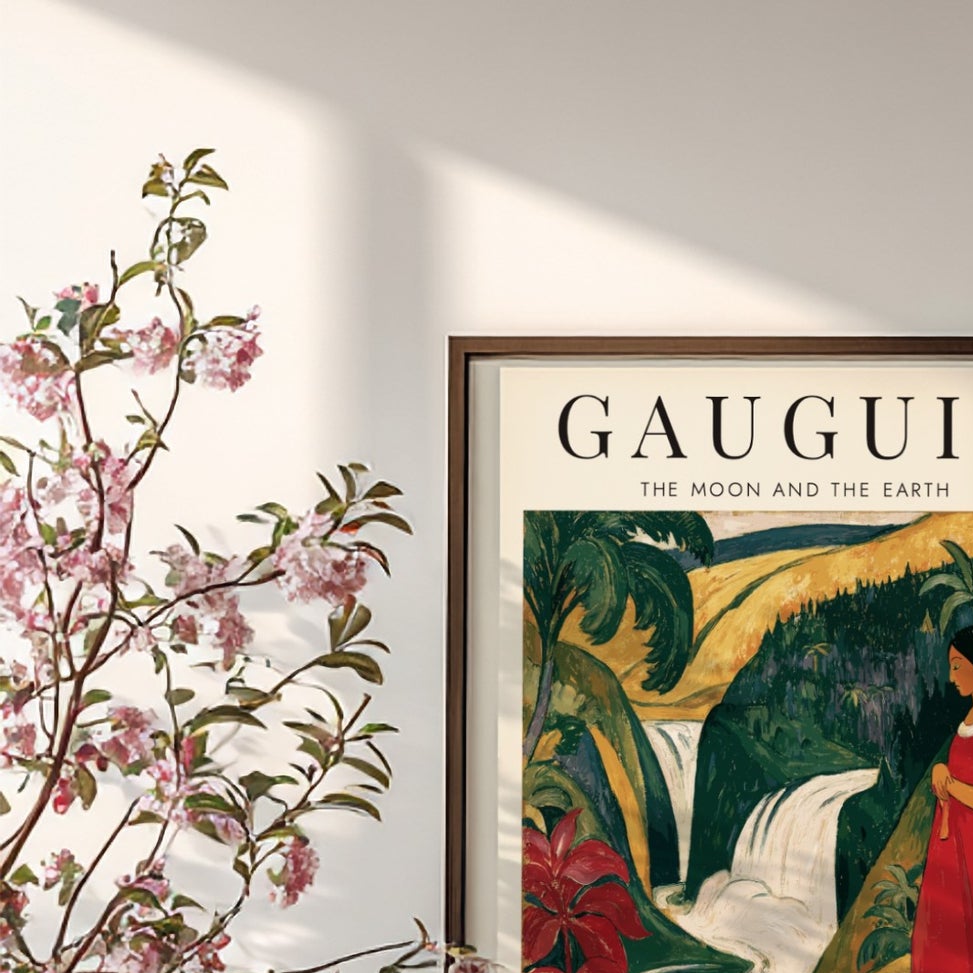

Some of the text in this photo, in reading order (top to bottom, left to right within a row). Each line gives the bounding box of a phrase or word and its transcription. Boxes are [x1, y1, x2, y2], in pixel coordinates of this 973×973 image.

[640, 481, 950, 498] THE MOON AND THE EARTH
